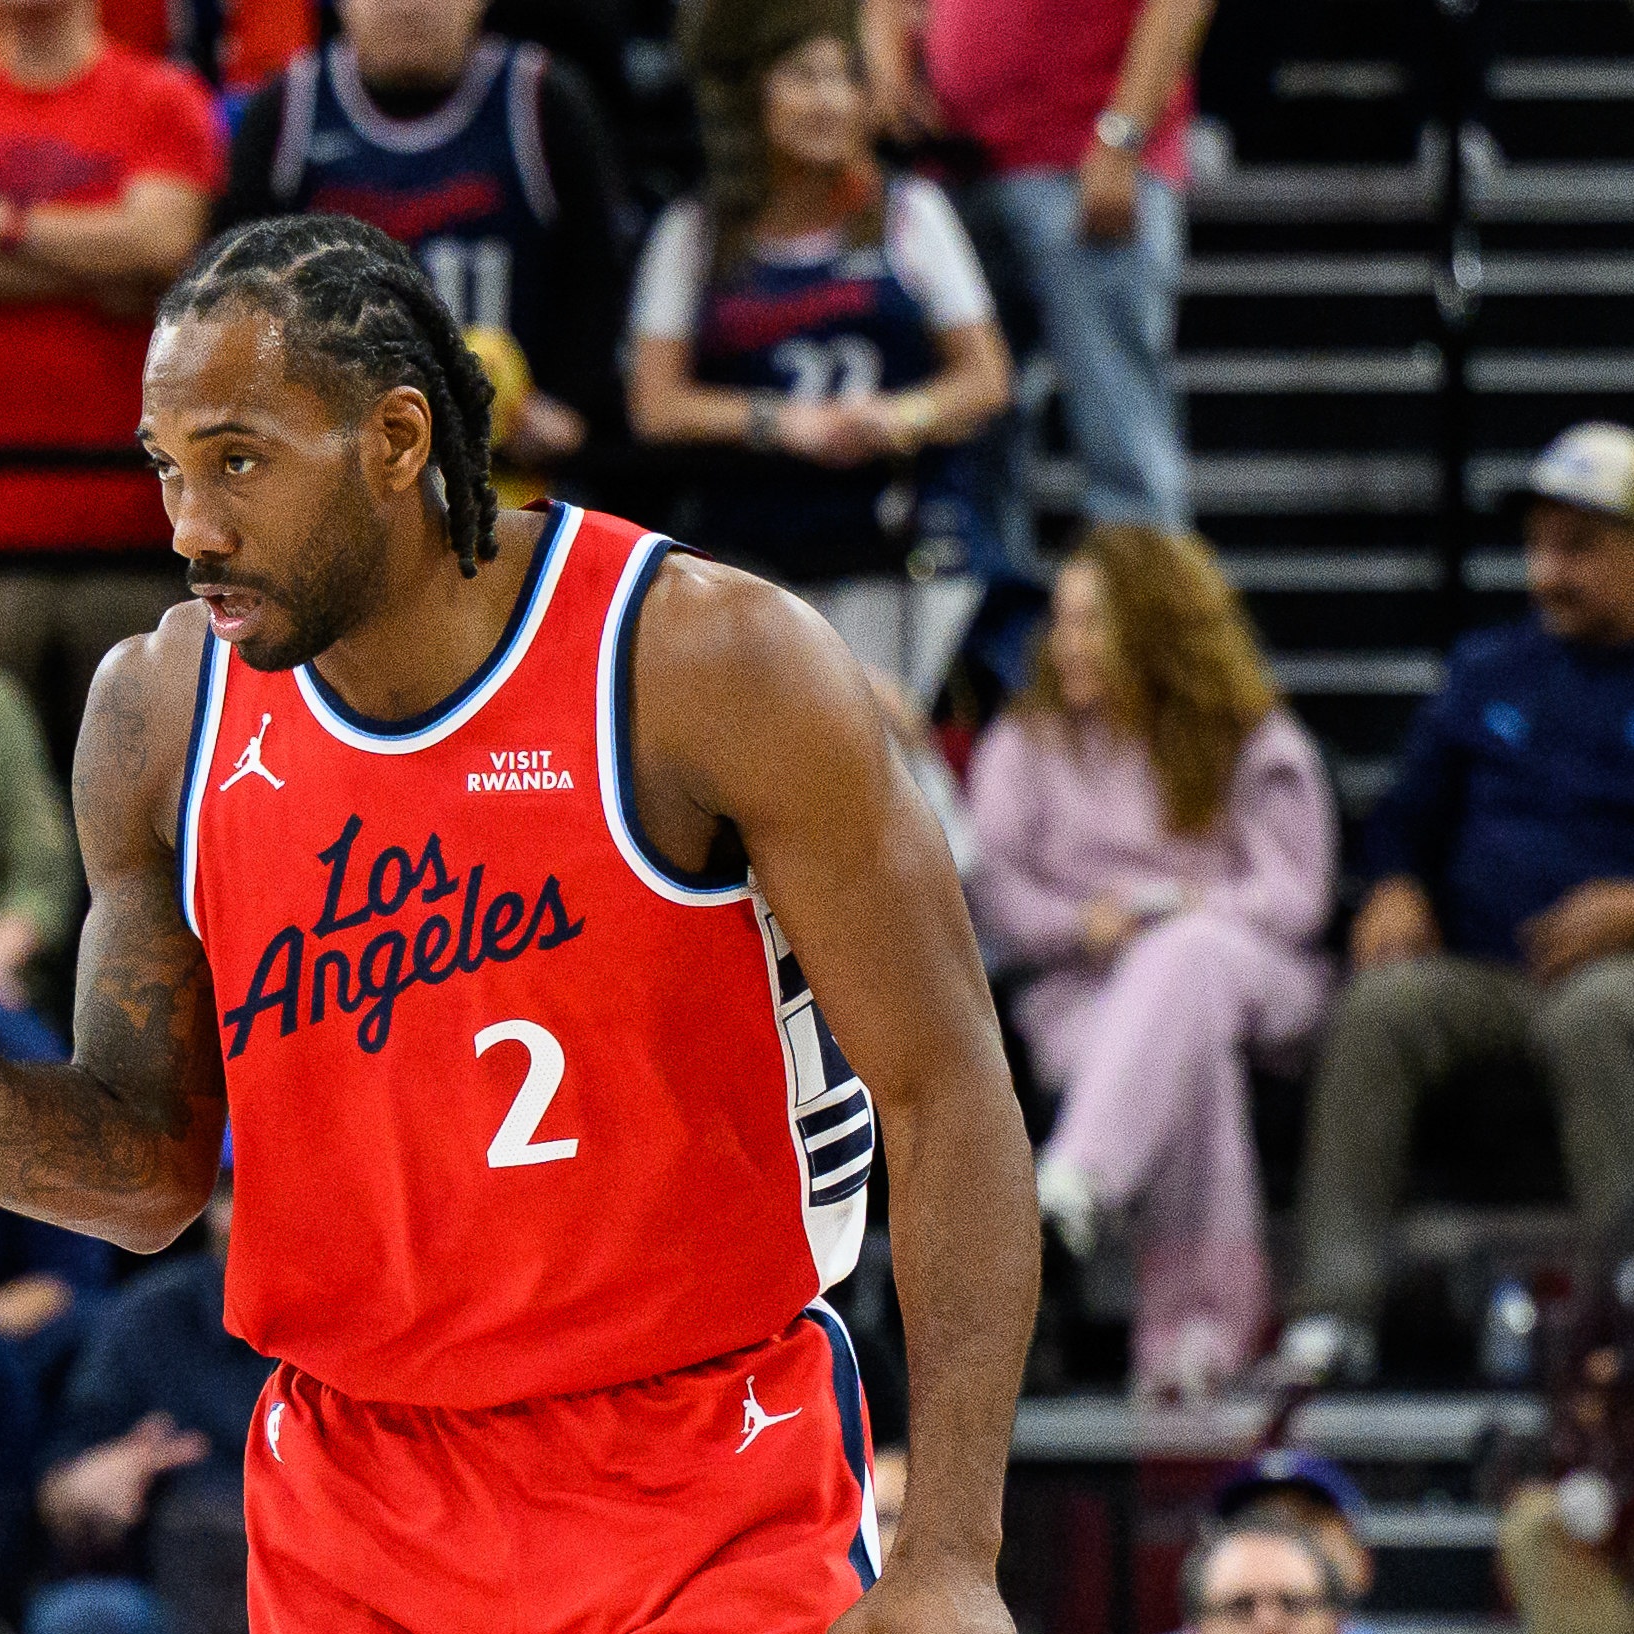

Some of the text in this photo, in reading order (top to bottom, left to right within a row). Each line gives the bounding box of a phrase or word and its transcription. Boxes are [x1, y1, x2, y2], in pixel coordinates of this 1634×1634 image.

[467, 770, 575, 792] RWANDA
[489, 750, 553, 771] VISIT
[312, 812, 460, 940] Los
[222, 873, 587, 1061] Angeles
[472, 1018, 580, 1169] 2
